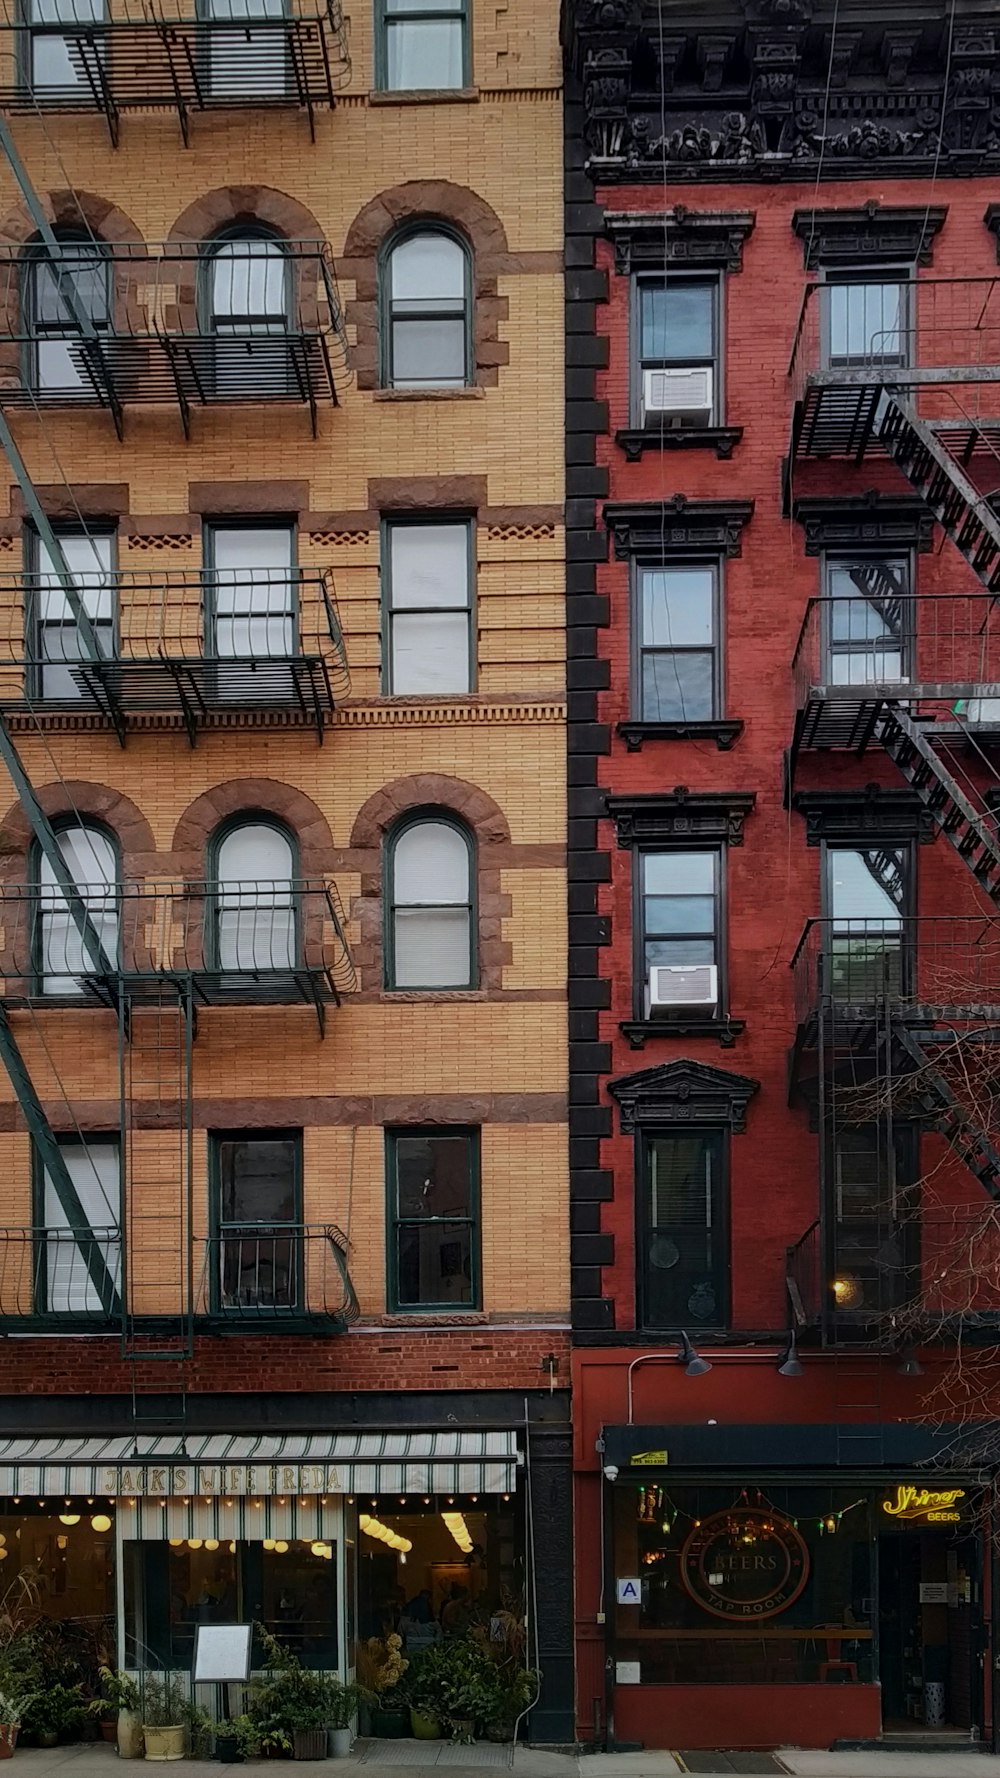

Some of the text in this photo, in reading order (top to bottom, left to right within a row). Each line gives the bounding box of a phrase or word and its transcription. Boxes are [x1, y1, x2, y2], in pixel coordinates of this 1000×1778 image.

[105, 1467, 341, 1492] JACK'S WIFE FREDA
[883, 1486, 966, 1515] Shiner
[927, 1512, 961, 1522] BEERS
[715, 1555, 777, 1570] BEERS
[622, 1582, 637, 1597] A
[707, 1592, 787, 1615] TAP ROOM
